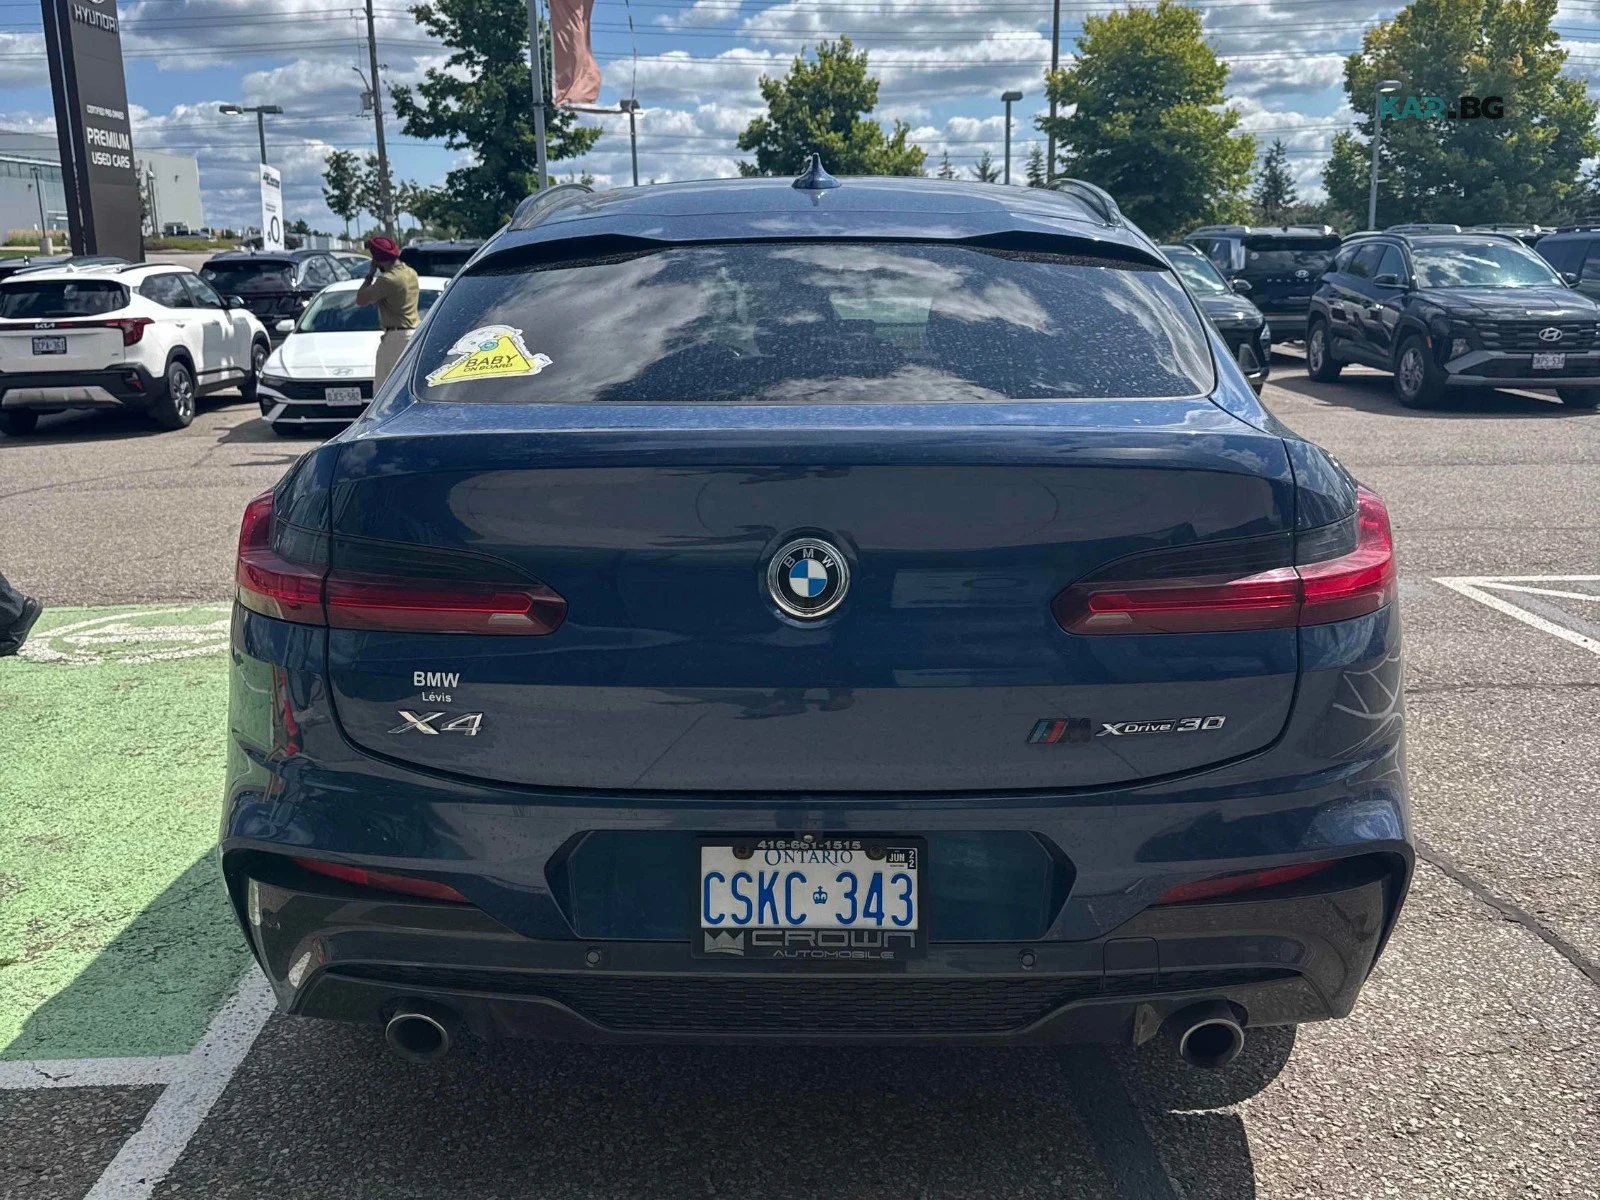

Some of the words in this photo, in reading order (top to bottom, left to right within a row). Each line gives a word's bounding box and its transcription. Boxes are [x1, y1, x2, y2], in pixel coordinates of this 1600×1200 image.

[73, 4, 119, 32] HYUNDAI
[86, 126, 130, 150] PREMIUM
[91, 151, 111, 166] USED
[112, 154, 131, 168] CARS
[465, 354, 518, 367] BABY
[478, 363, 513, 371] BOARD
[783, 548, 834, 568] BMW
[413, 671, 460, 688] BMW
[421, 691, 452, 702] Lévis
[387, 710, 483, 735] X4
[1176, 715, 1226, 732] 30
[888, 853, 905, 862] JUN
[703, 871, 807, 925] CSKC
[835, 871, 913, 926] 343
[751, 930, 916, 948] CROWN
[772, 950, 895, 959] AUTOMOBILE
